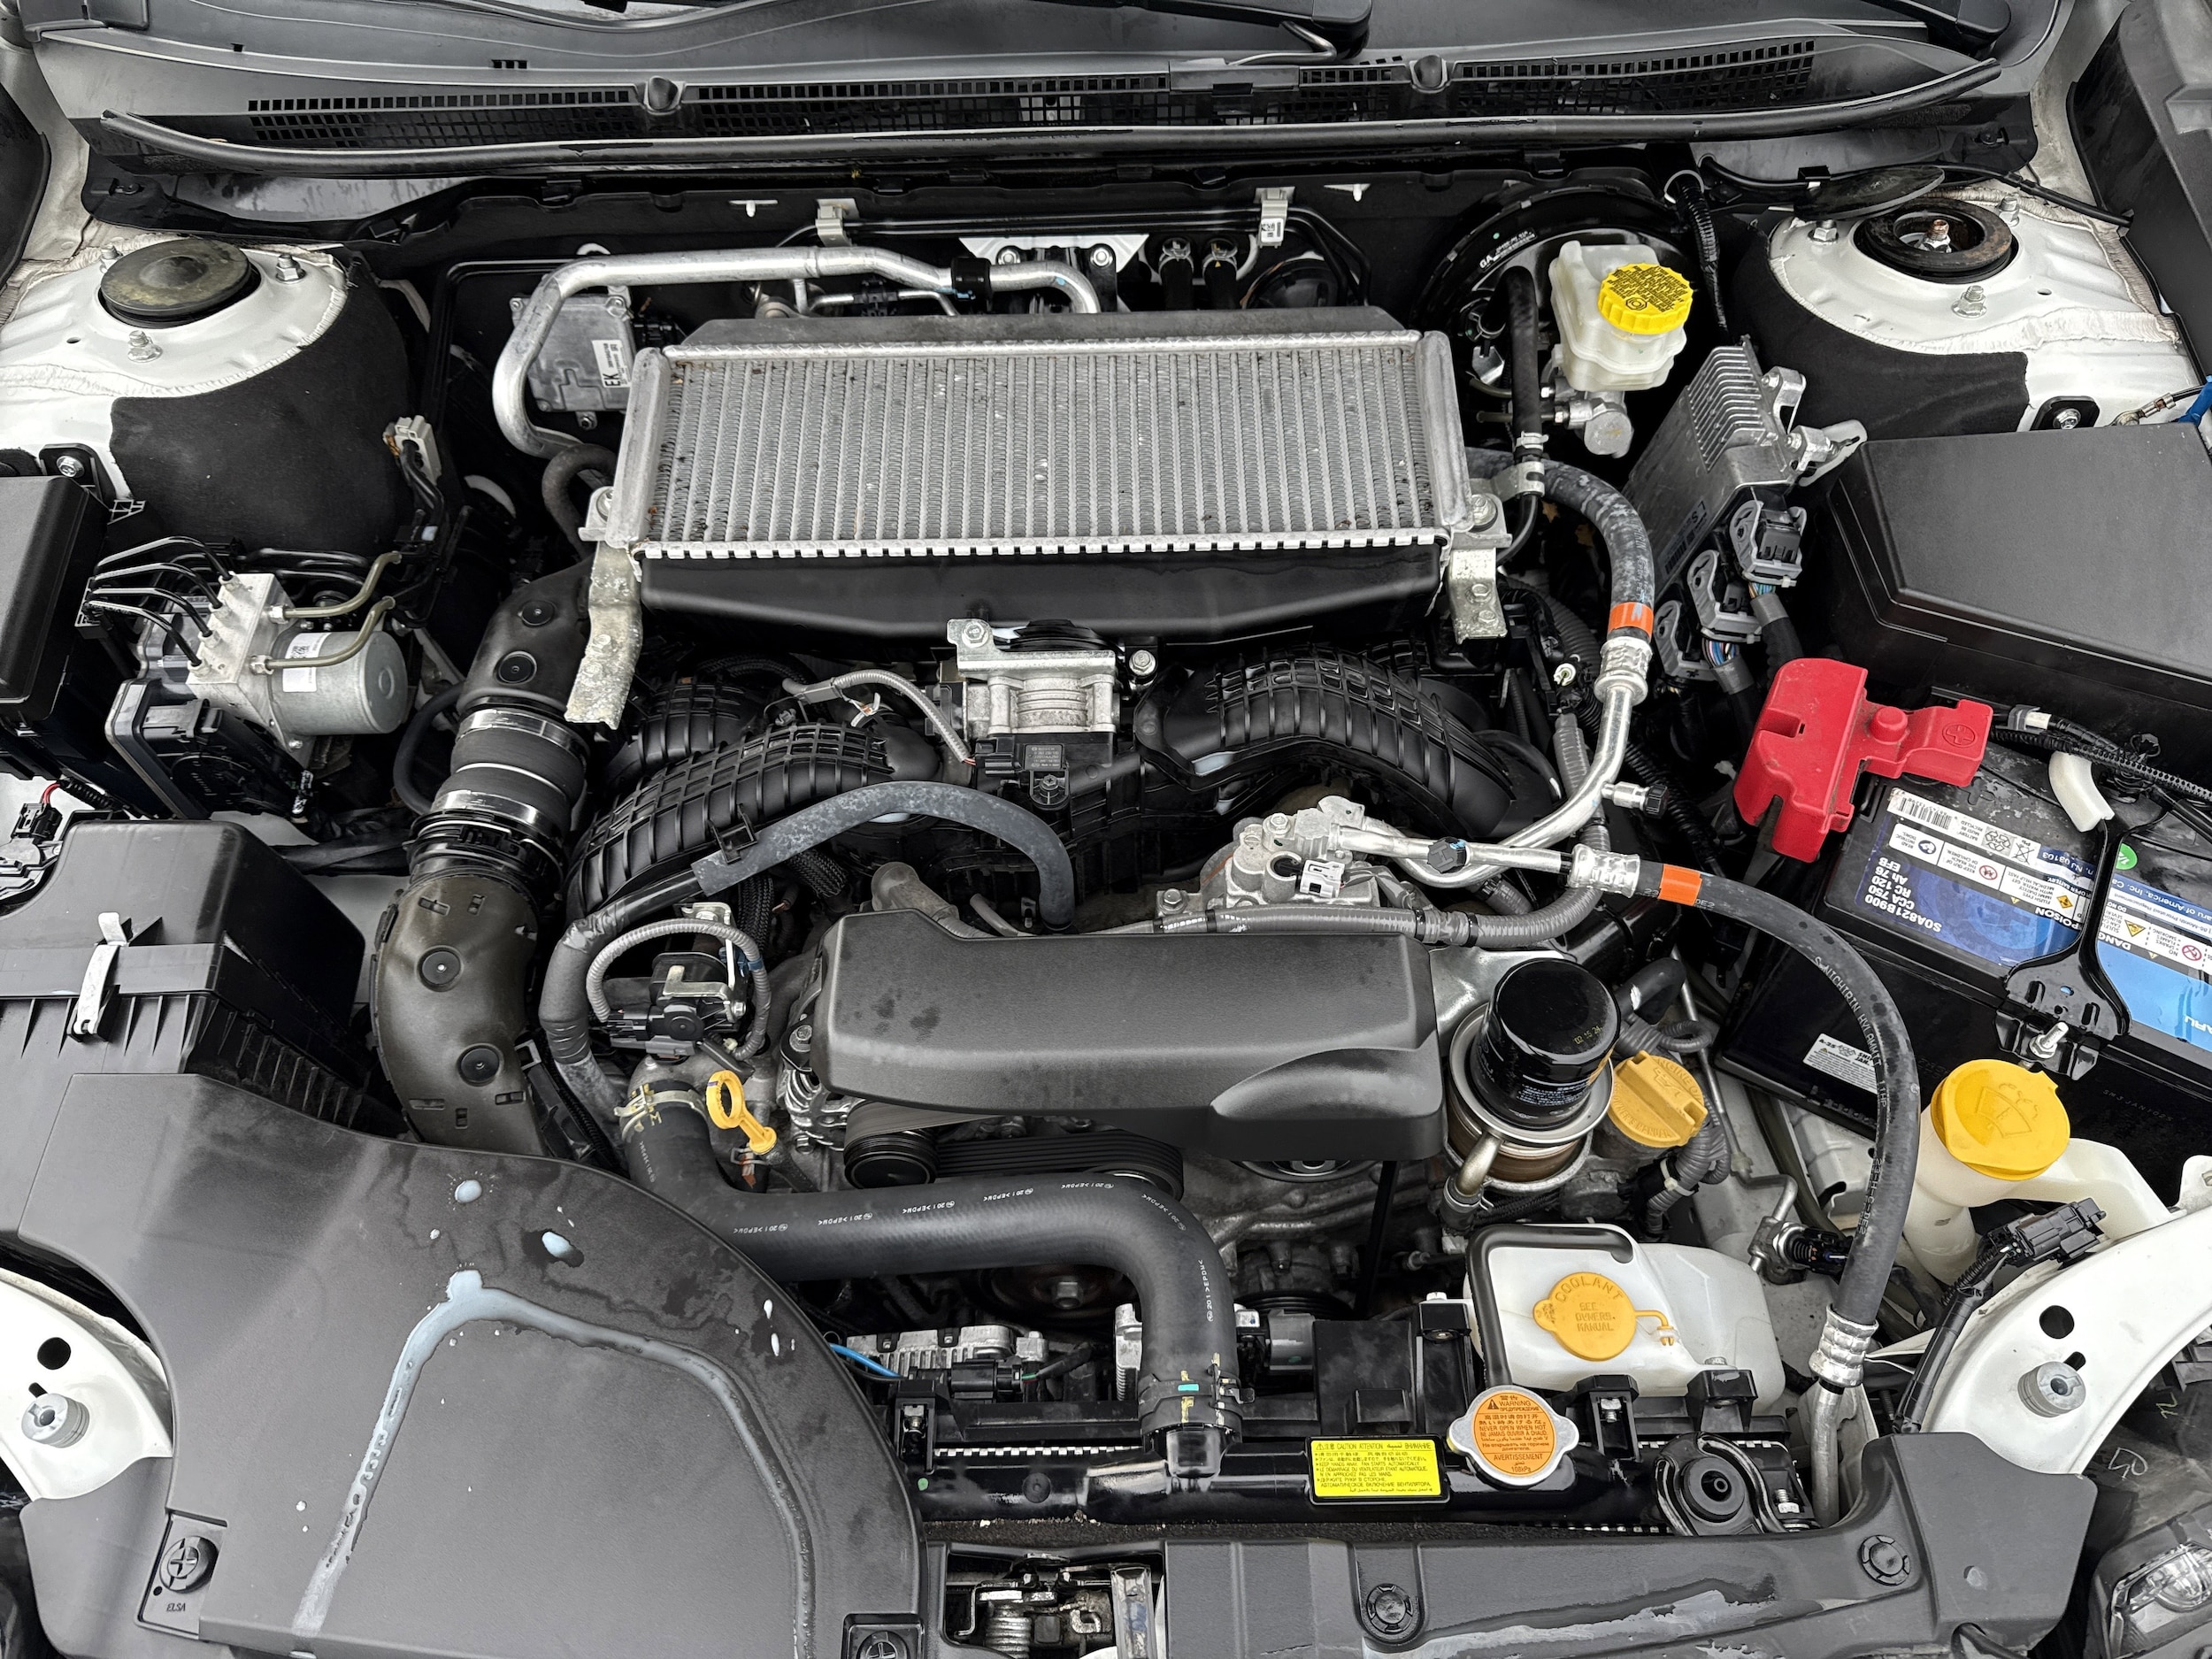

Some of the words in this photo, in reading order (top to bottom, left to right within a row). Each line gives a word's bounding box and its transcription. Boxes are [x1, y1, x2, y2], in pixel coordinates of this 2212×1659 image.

[602, 371, 620, 388] EK
[1960, 819, 1983, 832] RECYCLED
[1958, 830, 1978, 841] BATTERY
[1878, 856, 1901, 871] EFB
[1950, 856, 1967, 865] REACH
[2042, 849, 2070, 866] 08103
[1874, 865, 1890, 878] 76
[1961, 864, 1975, 873] KEEP
[2070, 862, 2083, 872] NJ
[1871, 875, 1893, 889] 120
[1890, 872, 1907, 885] Ah
[2019, 875, 2032, 884] HELP
[1868, 884, 1889, 899] 750
[1893, 884, 1911, 897] RC
[2070, 886, 2085, 895] OPEN
[2125, 883, 2143, 895] Inc.
[1890, 893, 1915, 909] CCA
[2034, 905, 2079, 929] POISON
[2185, 907, 2195, 916] of
[2153, 928, 2176, 941] SMOKING
[1819, 964, 1863, 1013] NICHIRIN
[1634, 1123, 1672, 1140] MANUAL
[1555, 1276, 1623, 1302] COOLANT
[1579, 1302, 1599, 1311] SEE
[1578, 1323, 1615, 1332] MANUAL
[165, 1602, 186, 1612] ELSA
